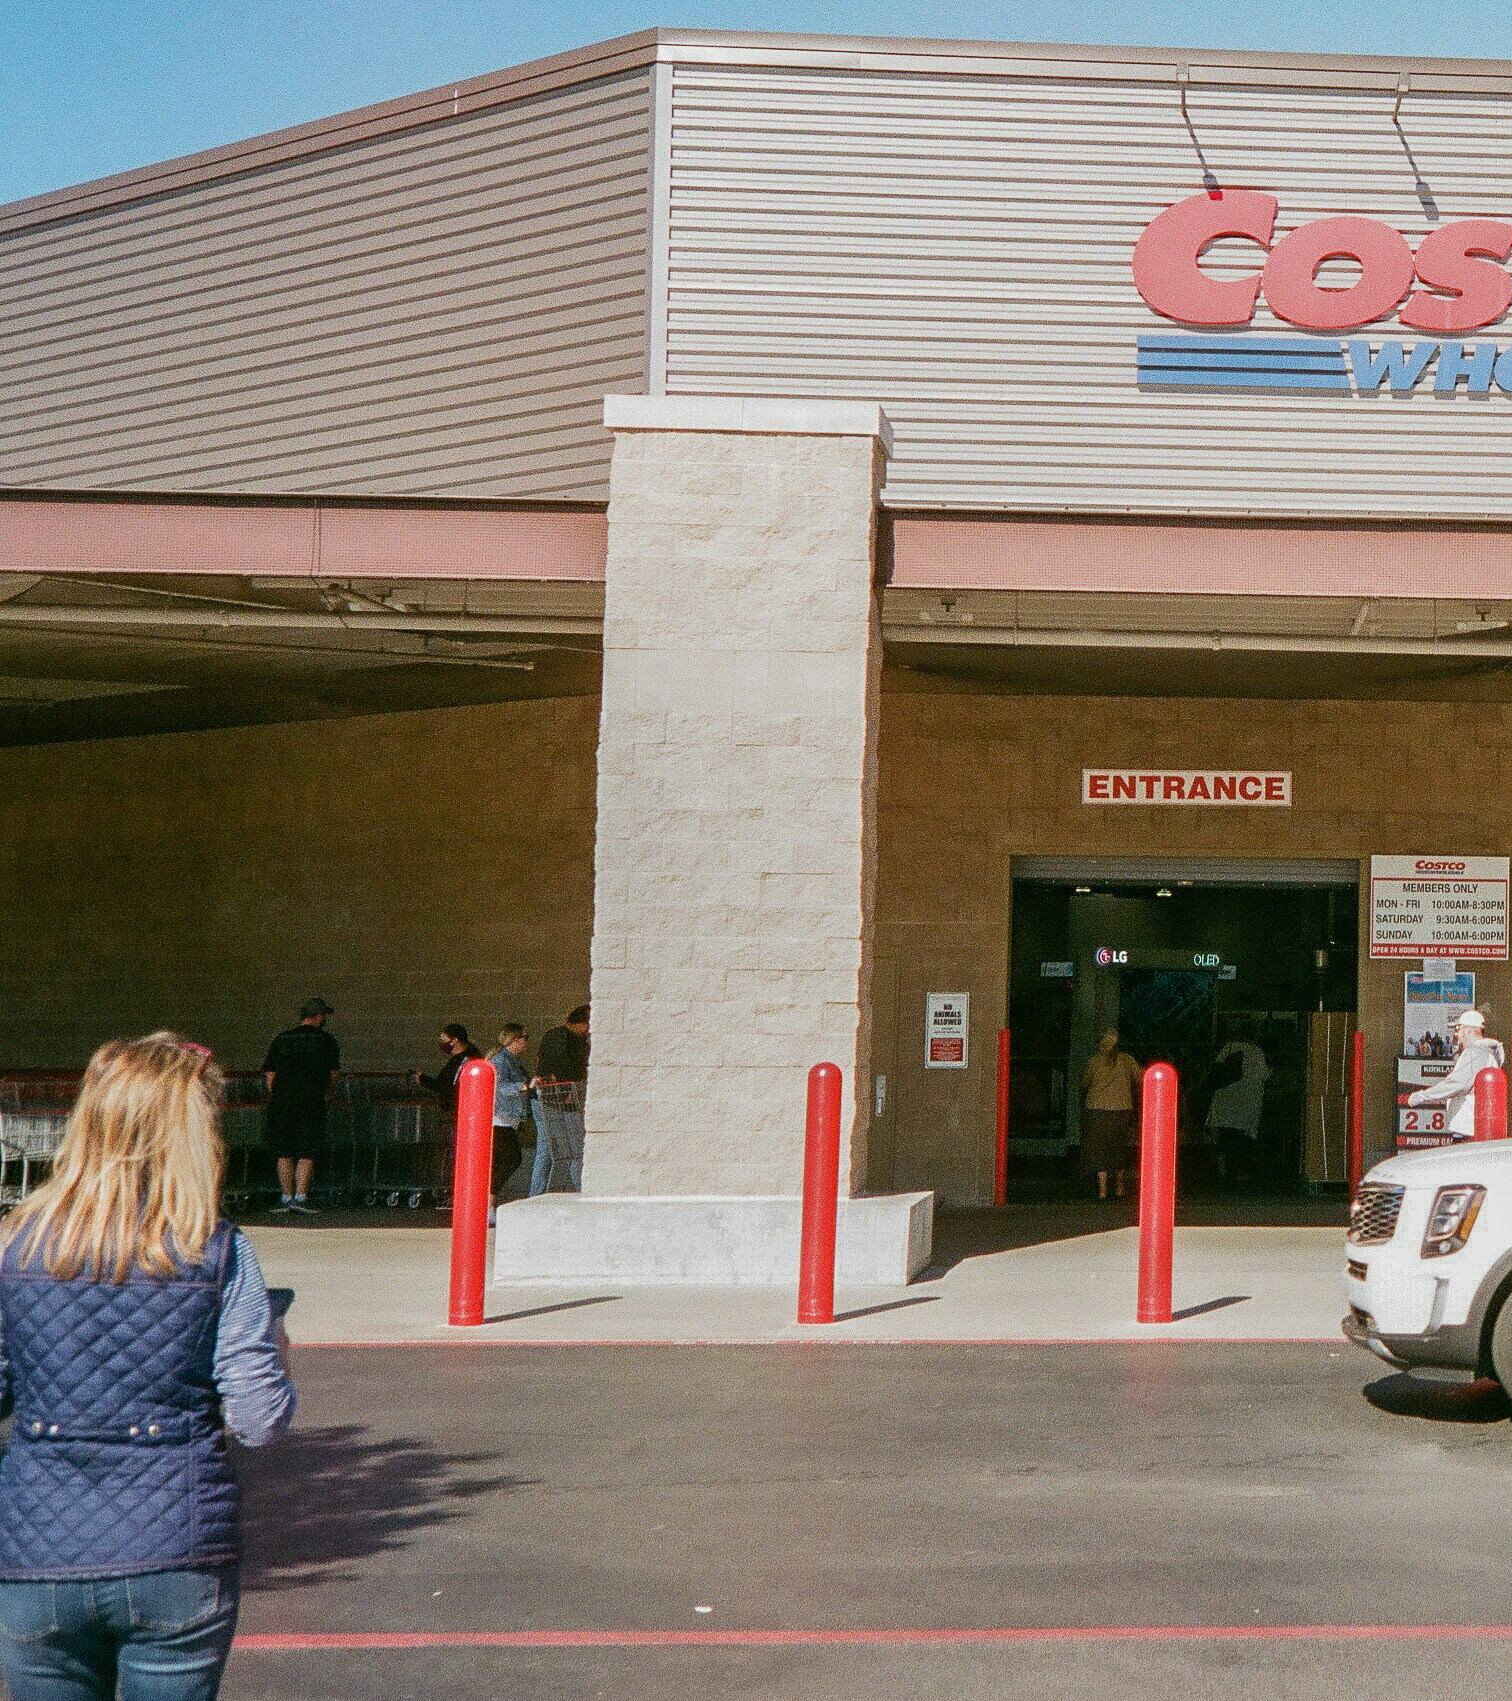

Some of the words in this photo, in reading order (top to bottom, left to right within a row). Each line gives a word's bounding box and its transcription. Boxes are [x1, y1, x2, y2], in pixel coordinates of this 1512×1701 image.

[1088, 774, 1285, 800] ENTRANCE
[1415, 860, 1465, 870] COSTCO
[1402, 883, 1450, 893] MEMBERS
[1453, 883, 1479, 894] ONLY
[1376, 899, 1398, 909] MON
[1406, 900, 1421, 909] FRI
[1432, 900, 1505, 910] 10:00AM-8:30PM
[1376, 914, 1424, 924] SATURDAY
[1436, 915, 1505, 925] 9:30AM-6:00PM
[1376, 930, 1413, 940] SUNDAY
[1431, 931, 1505, 941] 10:00AM-6:00PM
[1448, 947, 1506, 955] WWW.COSTCO.COM
[1112, 951, 1128, 963] LG
[1193, 953, 1220, 967] OLED
[1423, 1065, 1454, 1073] KIRKLAN
[1406, 1137, 1440, 1146] PREMIUM
